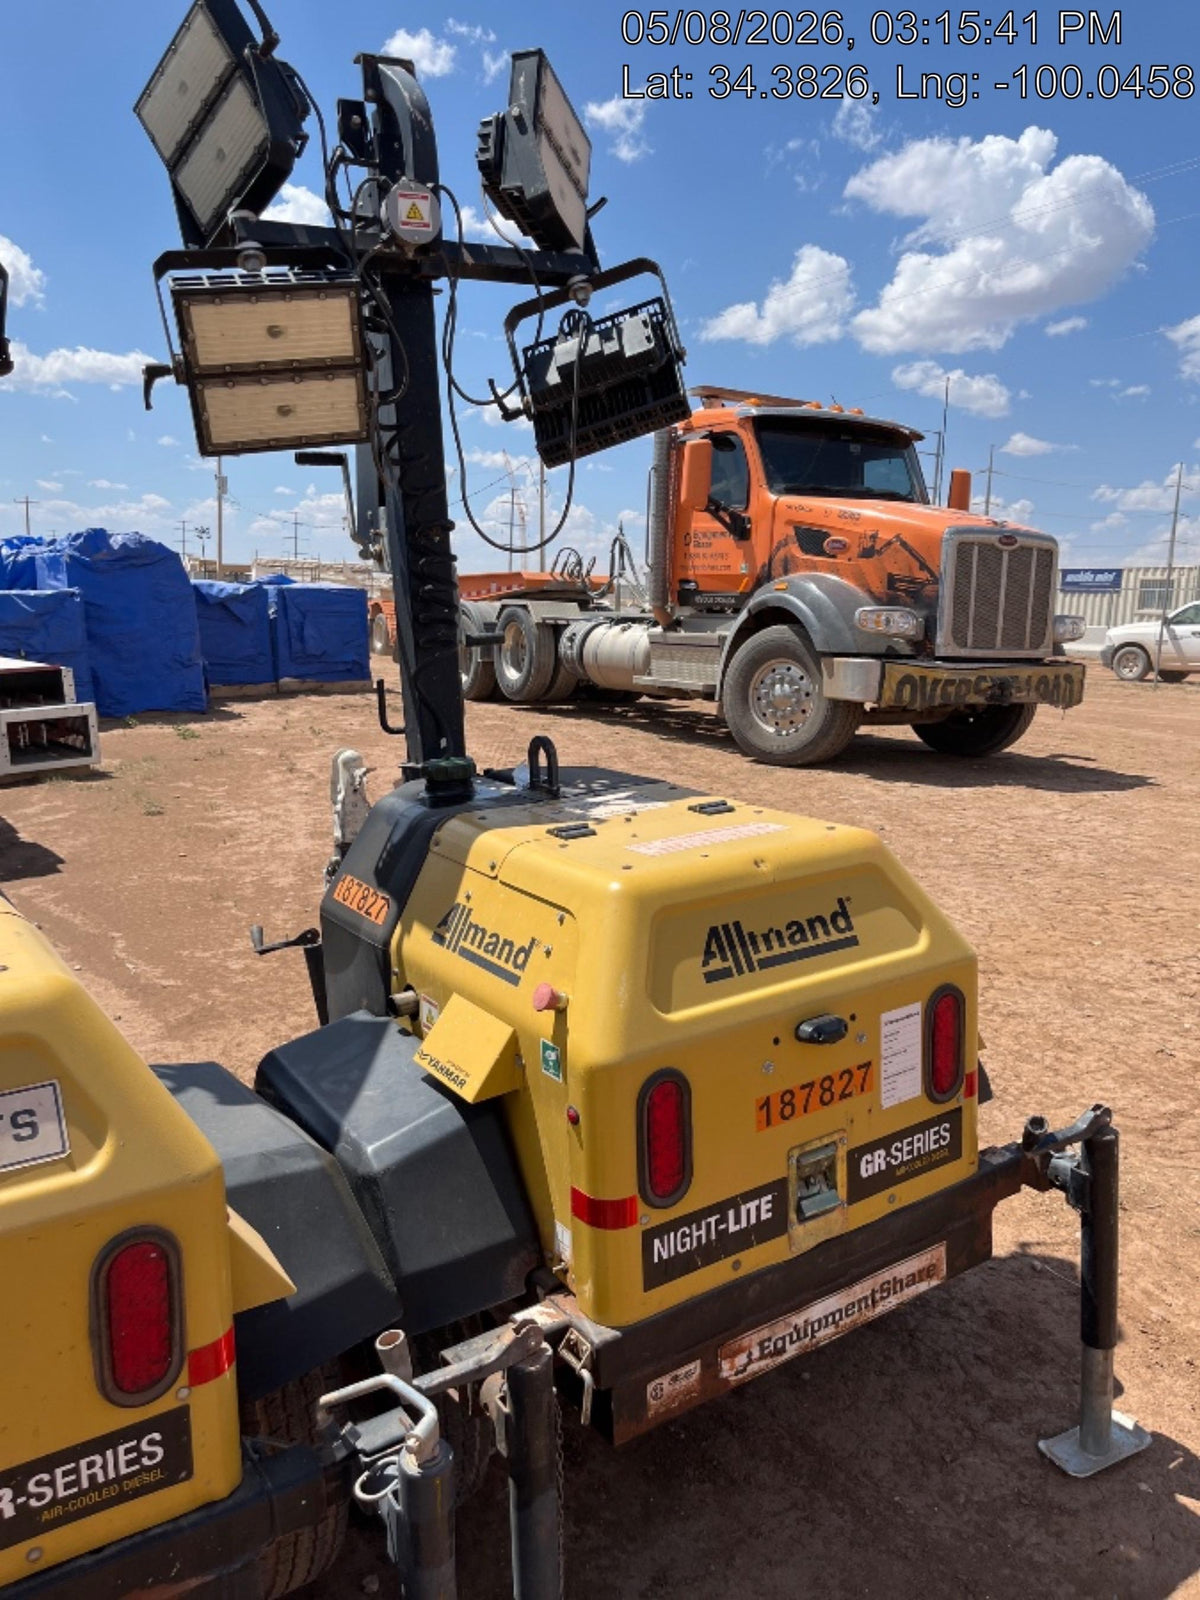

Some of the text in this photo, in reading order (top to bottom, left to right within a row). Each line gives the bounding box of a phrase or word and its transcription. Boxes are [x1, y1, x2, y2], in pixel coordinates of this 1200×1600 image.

[336, 874, 391, 922] 187827
[432, 902, 537, 974] Allmand
[702, 897, 855, 976] Allmand
[427, 1056, 467, 1090] YANMAR
[758, 1060, 873, 1128] 187827
[859, 1123, 951, 1179] GR-SERIES
[653, 1194, 773, 1264] NIGHT-LITE
[757, 1260, 938, 1361] EquipmentShare
[41, 1468, 165, 1523] AIR-COOLED DIESEL
